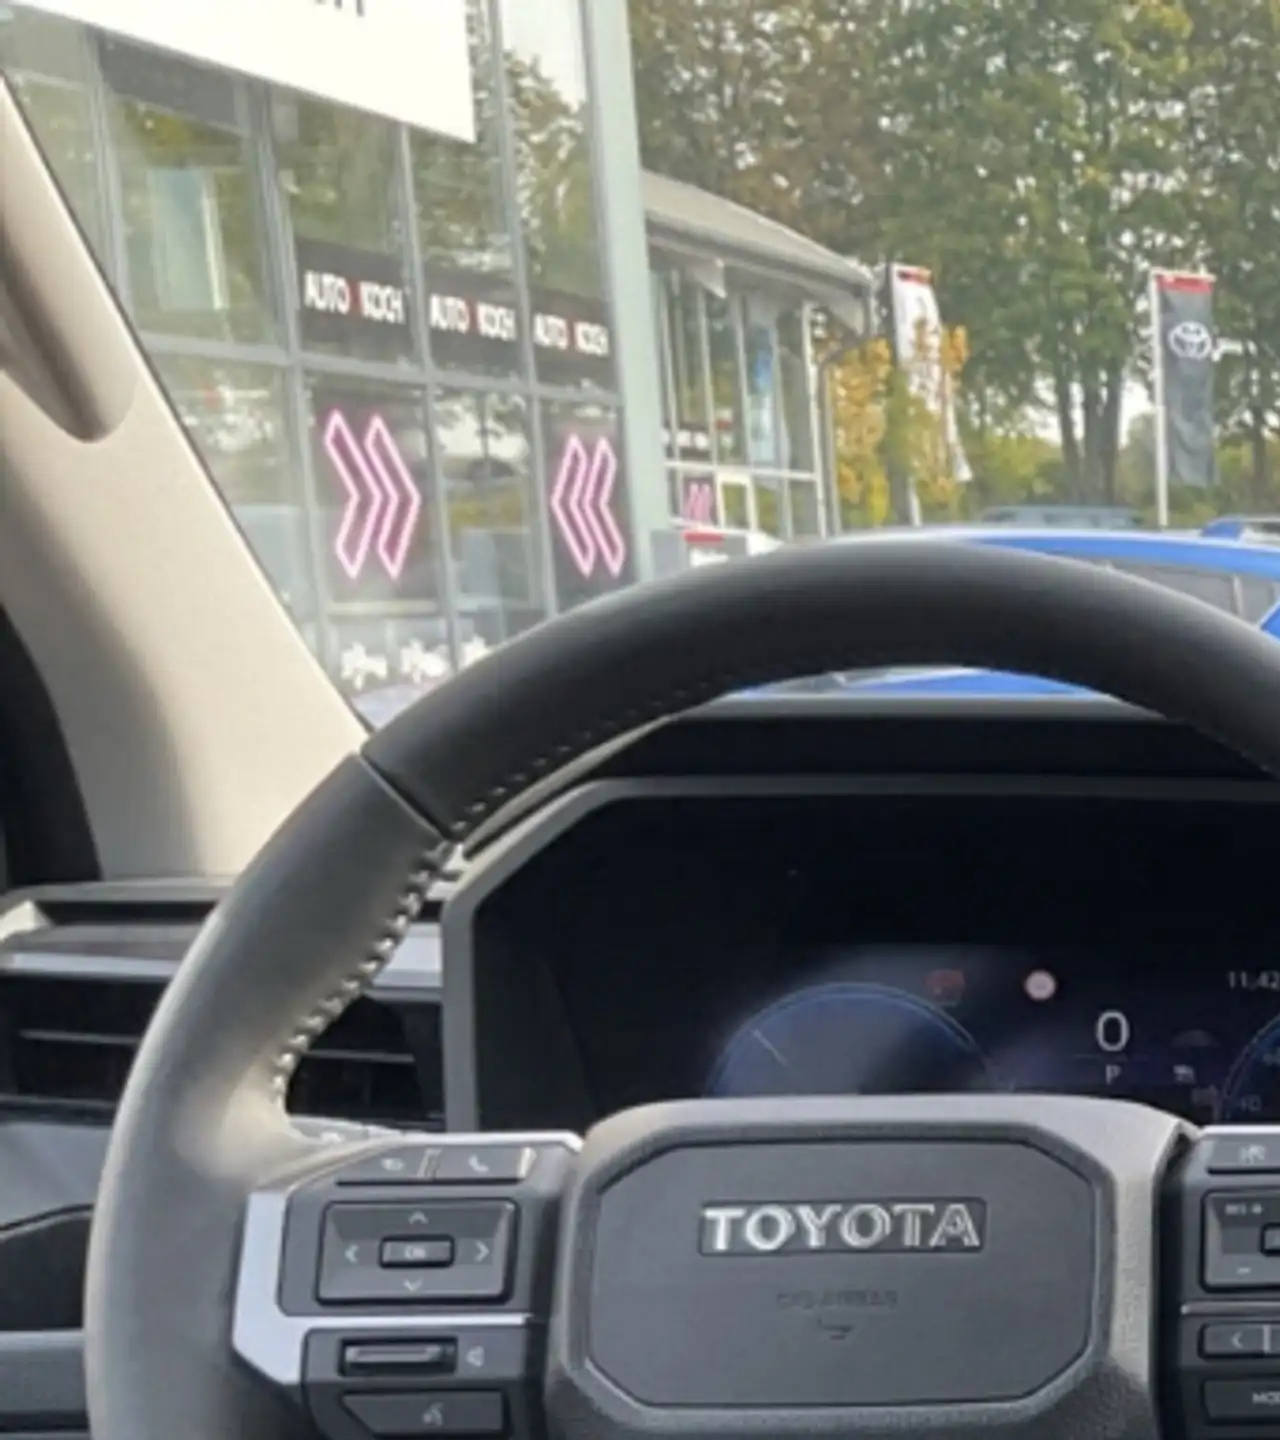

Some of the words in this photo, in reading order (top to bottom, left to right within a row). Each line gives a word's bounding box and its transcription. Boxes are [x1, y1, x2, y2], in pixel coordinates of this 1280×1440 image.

[304, 269, 350, 315] AUTO
[430, 293, 469, 334] AUTO
[703, 1203, 982, 1252] TOYOTA
